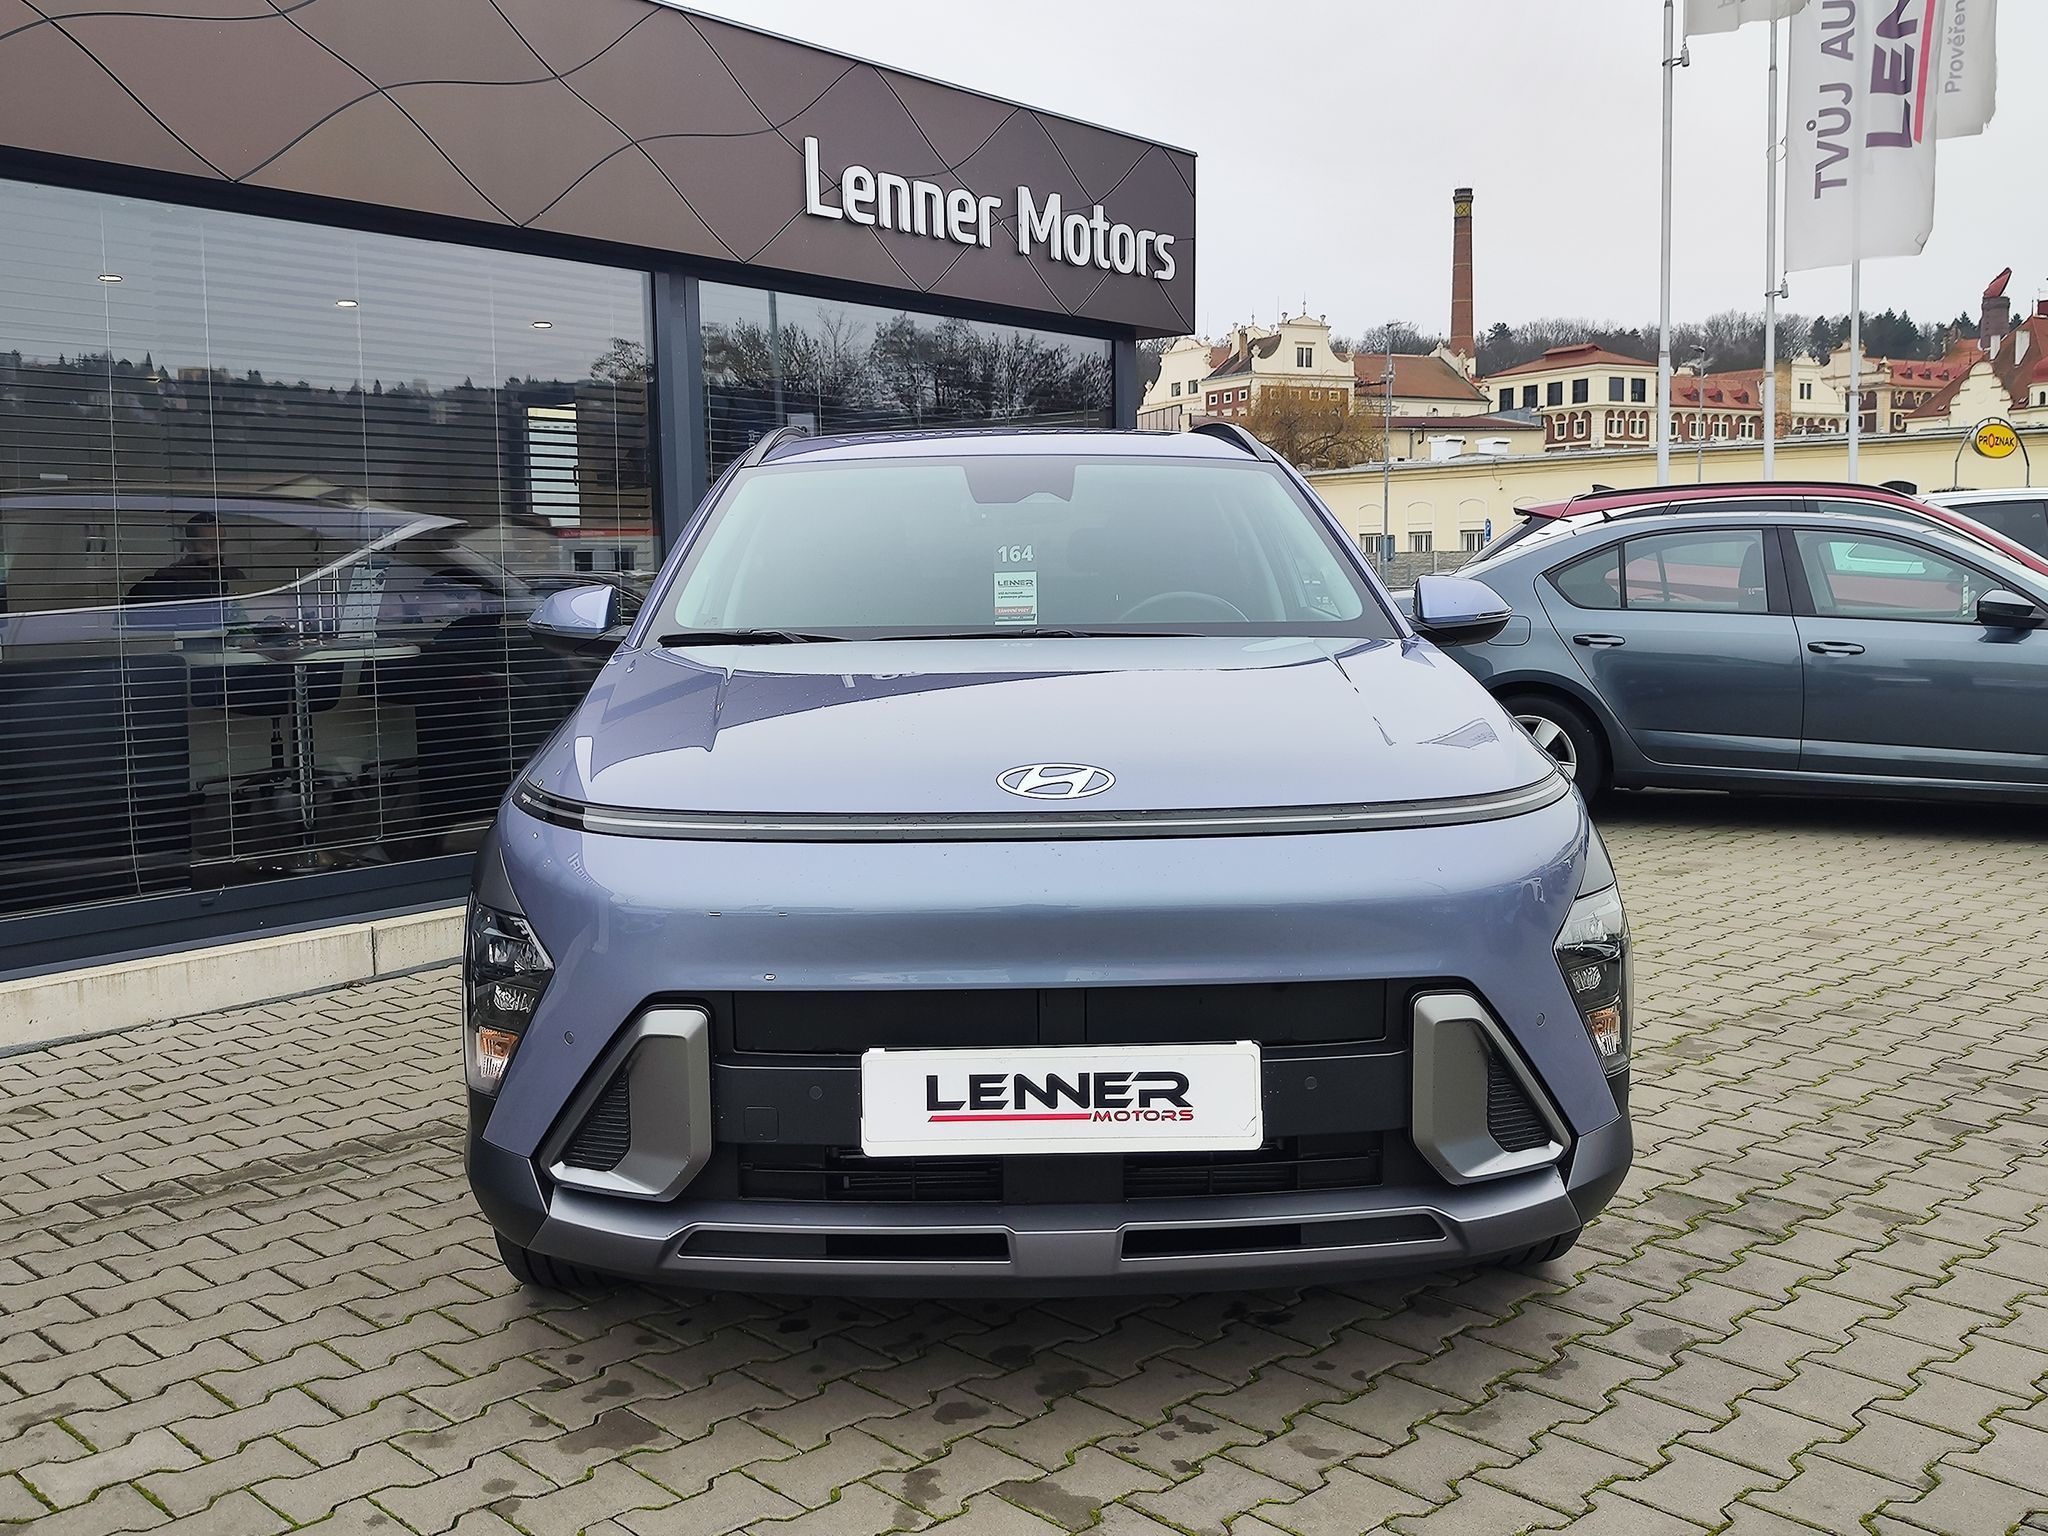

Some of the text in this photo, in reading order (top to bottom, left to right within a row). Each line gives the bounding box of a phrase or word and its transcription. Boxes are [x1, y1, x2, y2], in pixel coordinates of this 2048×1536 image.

[1806, 82, 1853, 200] TVŮJ
[804, 135, 1176, 281] Lenner Motors
[997, 544, 1034, 563] 164
[926, 1071, 1194, 1112] LENNER
[1092, 1109, 1194, 1122] MOTORS
